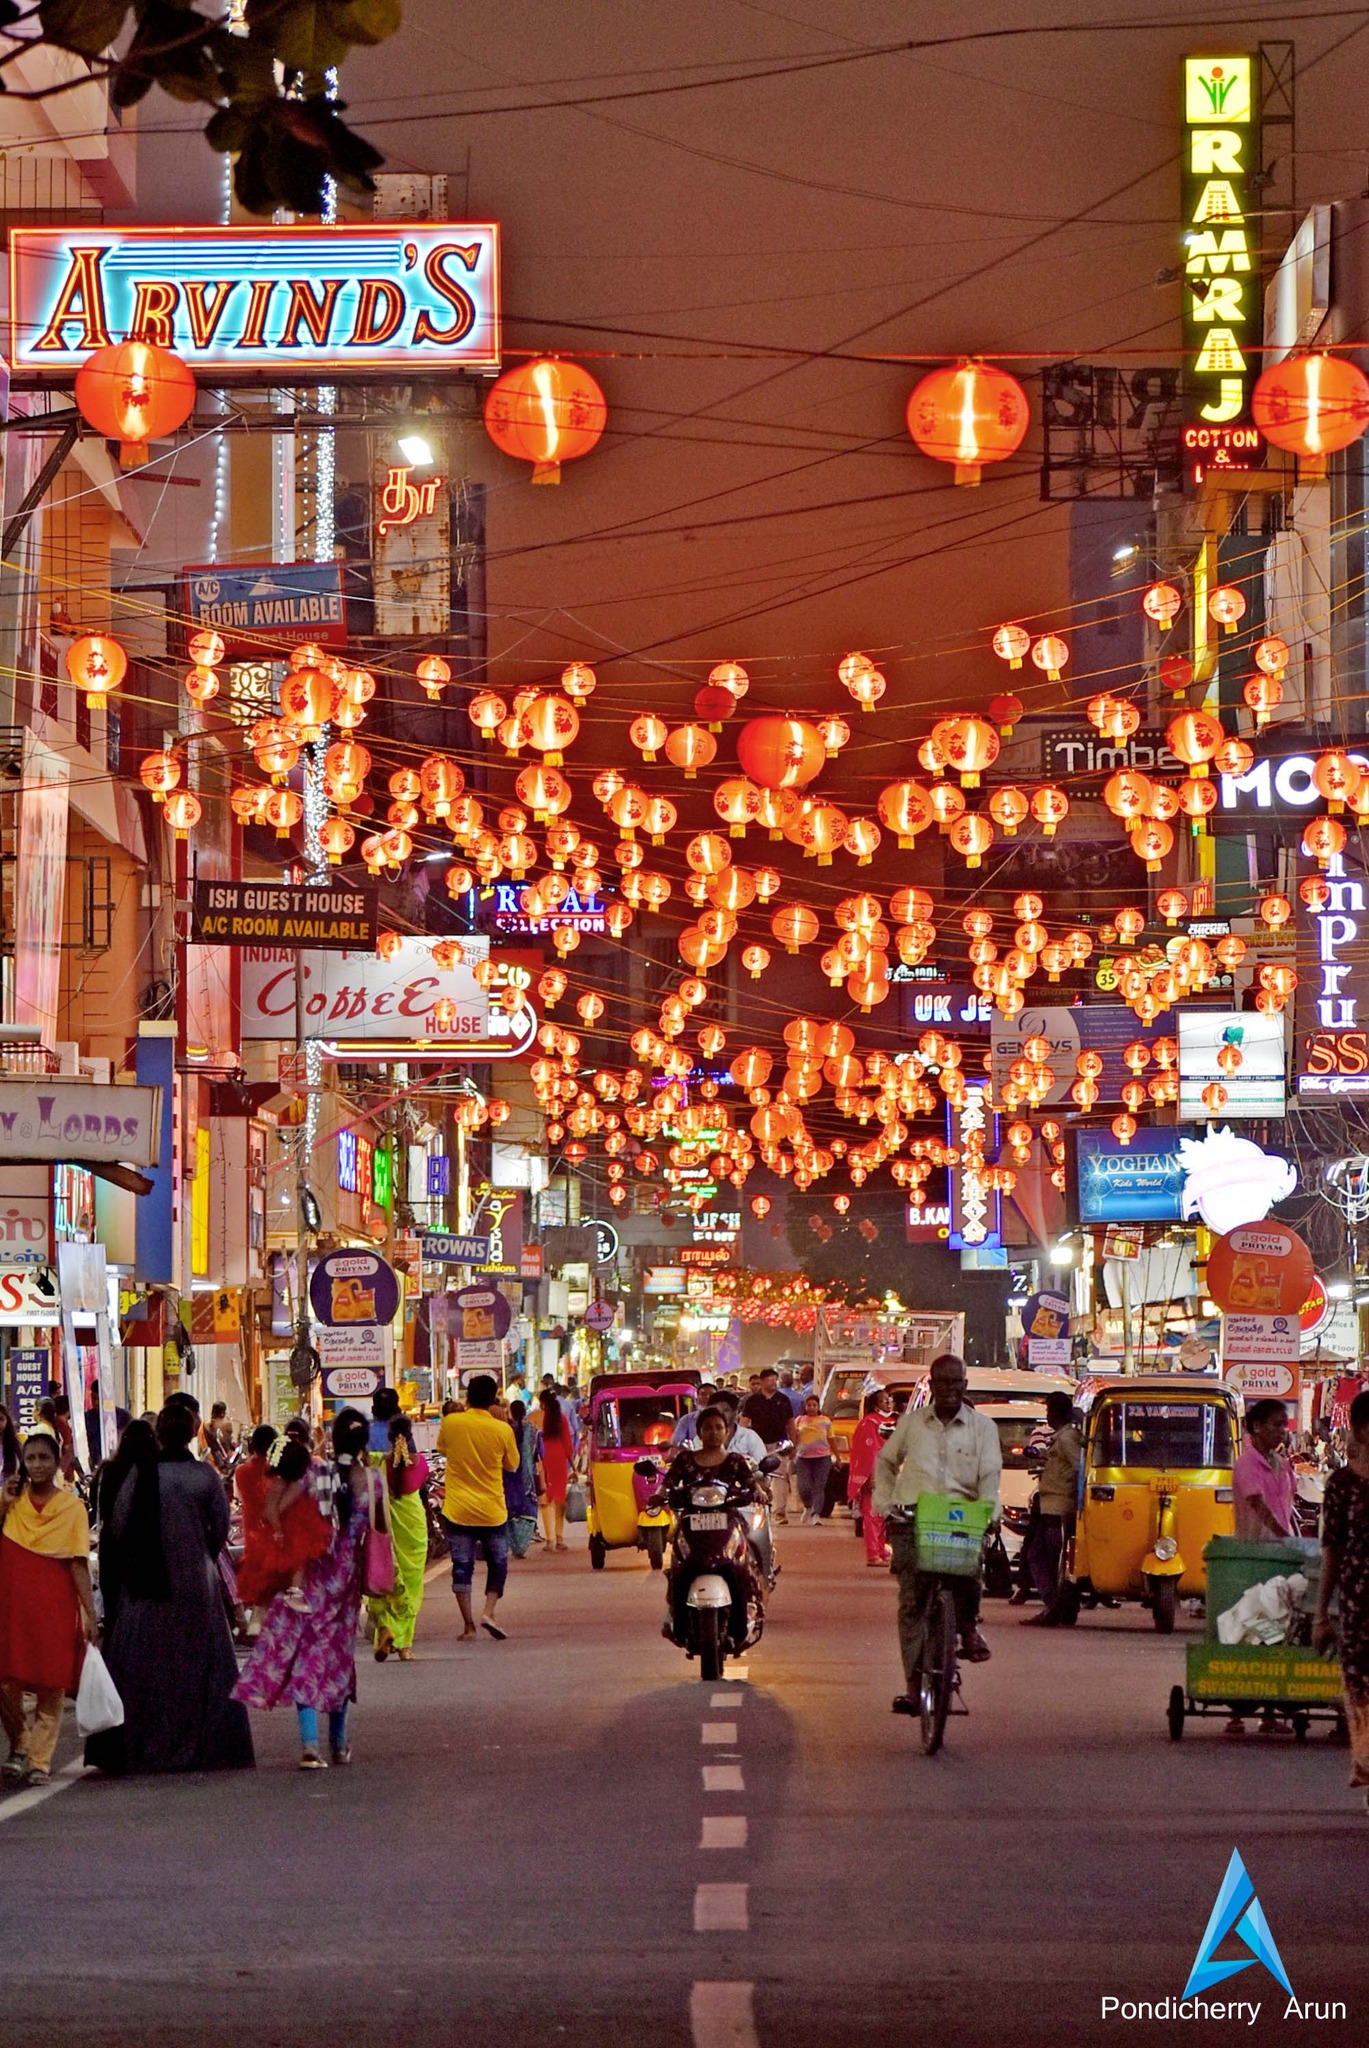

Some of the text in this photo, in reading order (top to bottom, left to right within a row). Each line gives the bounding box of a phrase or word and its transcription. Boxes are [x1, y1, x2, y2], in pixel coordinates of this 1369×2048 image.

[1185, 130, 1251, 423] RAMRAJ
[31, 243, 482, 352] ARVIND'S
[1185, 429, 1258, 448] COTTON
[1215, 449, 1231, 463] &
[199, 580, 219, 595] A/C
[200, 596, 339, 628] ROOM AVAILABLE
[286, 630, 329, 642] House
[208, 888, 365, 914] ISH GUEST HOUSE
[497, 886, 604, 912] RAL
[202, 916, 369, 940] A/C ROOM AVAILABLE
[1188, 926, 1230, 935] CHICKEN
[1101, 973, 1115, 985] 35
[914, 995, 952, 1021] UK
[426, 1016, 481, 1034] HOUSE
[996, 1040, 1072, 1054] GENYS
[1306, 1035, 1369, 1074] SS
[1112, 1177, 1162, 1188] Kids World
[1251, 1234, 1281, 1244] gold
[1241, 1242, 1282, 1251] PRIYAM
[681, 1246, 731, 1262] ராயல்
[342, 1258, 367, 1267] gold
[22, 1352, 35, 1360] ISH
[17, 1363, 42, 1371] GUEST
[1250, 1367, 1276, 1379] gold
[16, 1373, 42, 1381] HOUSE
[345, 1371, 367, 1380] gold
[16, 1385, 42, 1395] A/C
[1242, 1380, 1279, 1388] PRIYAM
